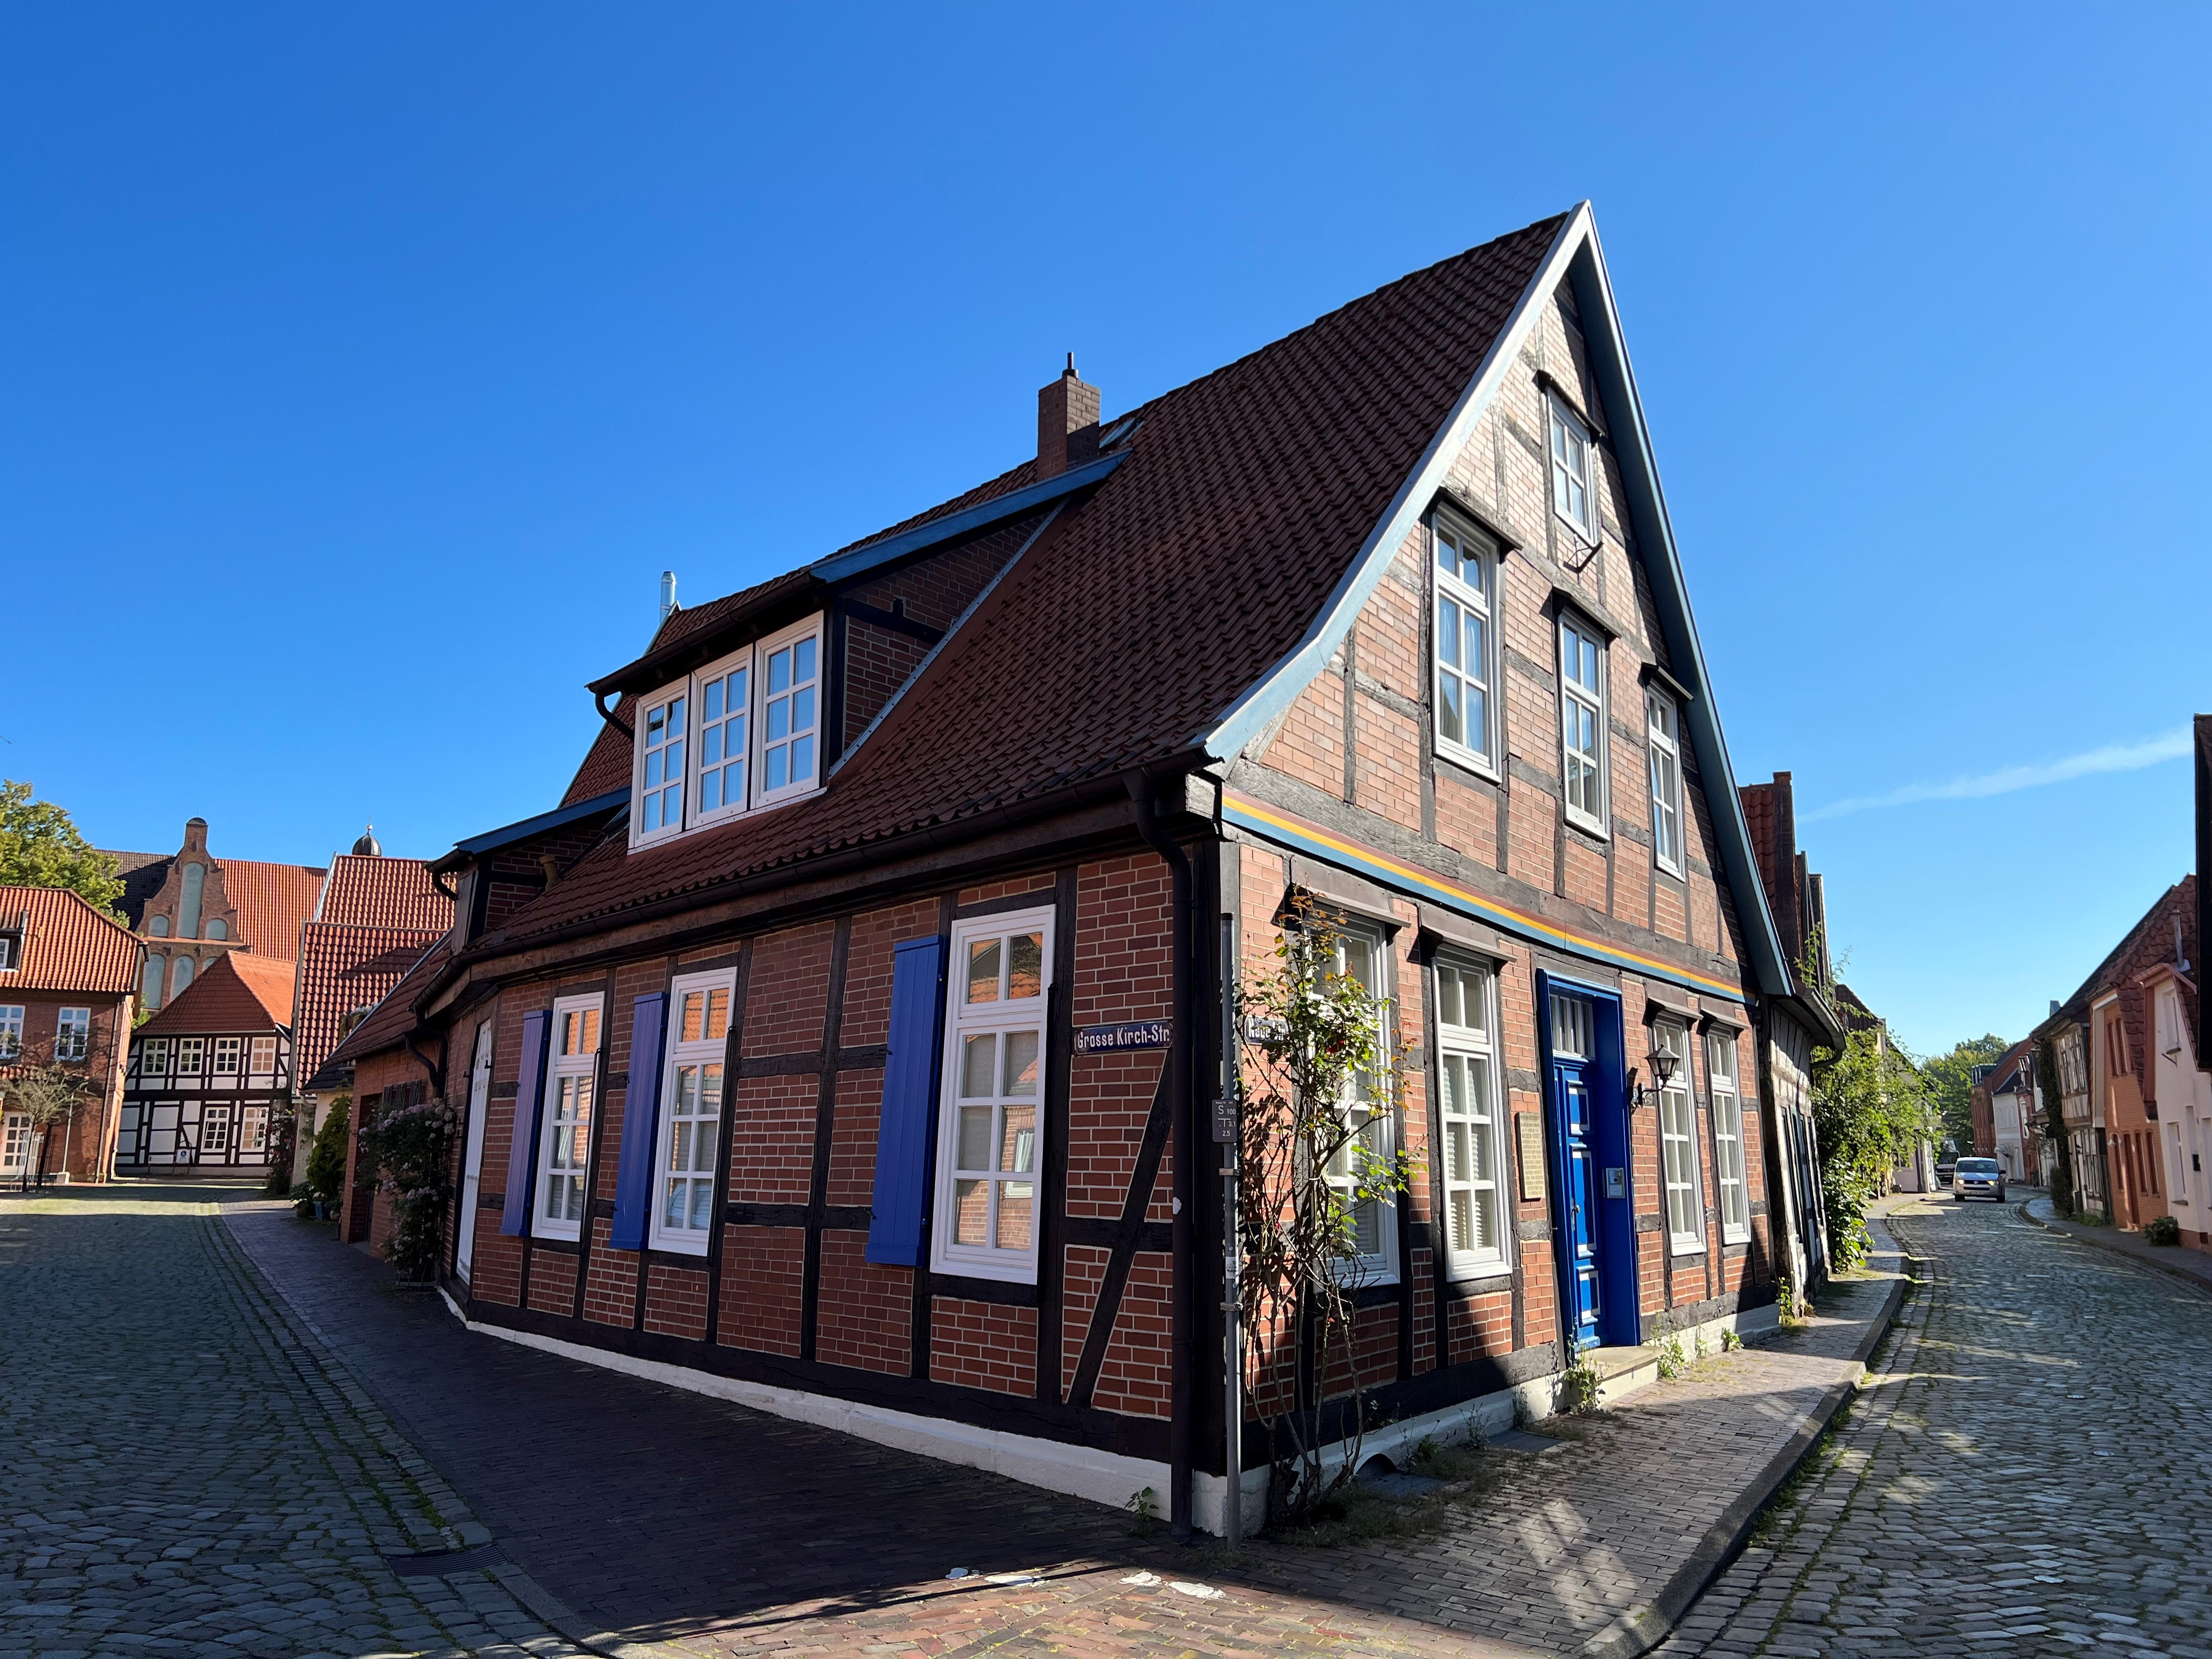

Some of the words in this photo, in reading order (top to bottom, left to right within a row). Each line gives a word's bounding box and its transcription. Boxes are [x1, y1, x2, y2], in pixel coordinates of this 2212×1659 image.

[1077, 1031, 1114, 1048] Grosse
[1116, 1024, 1170, 1045] Kirch-Str.
[1218, 1105, 1224, 1115] S
